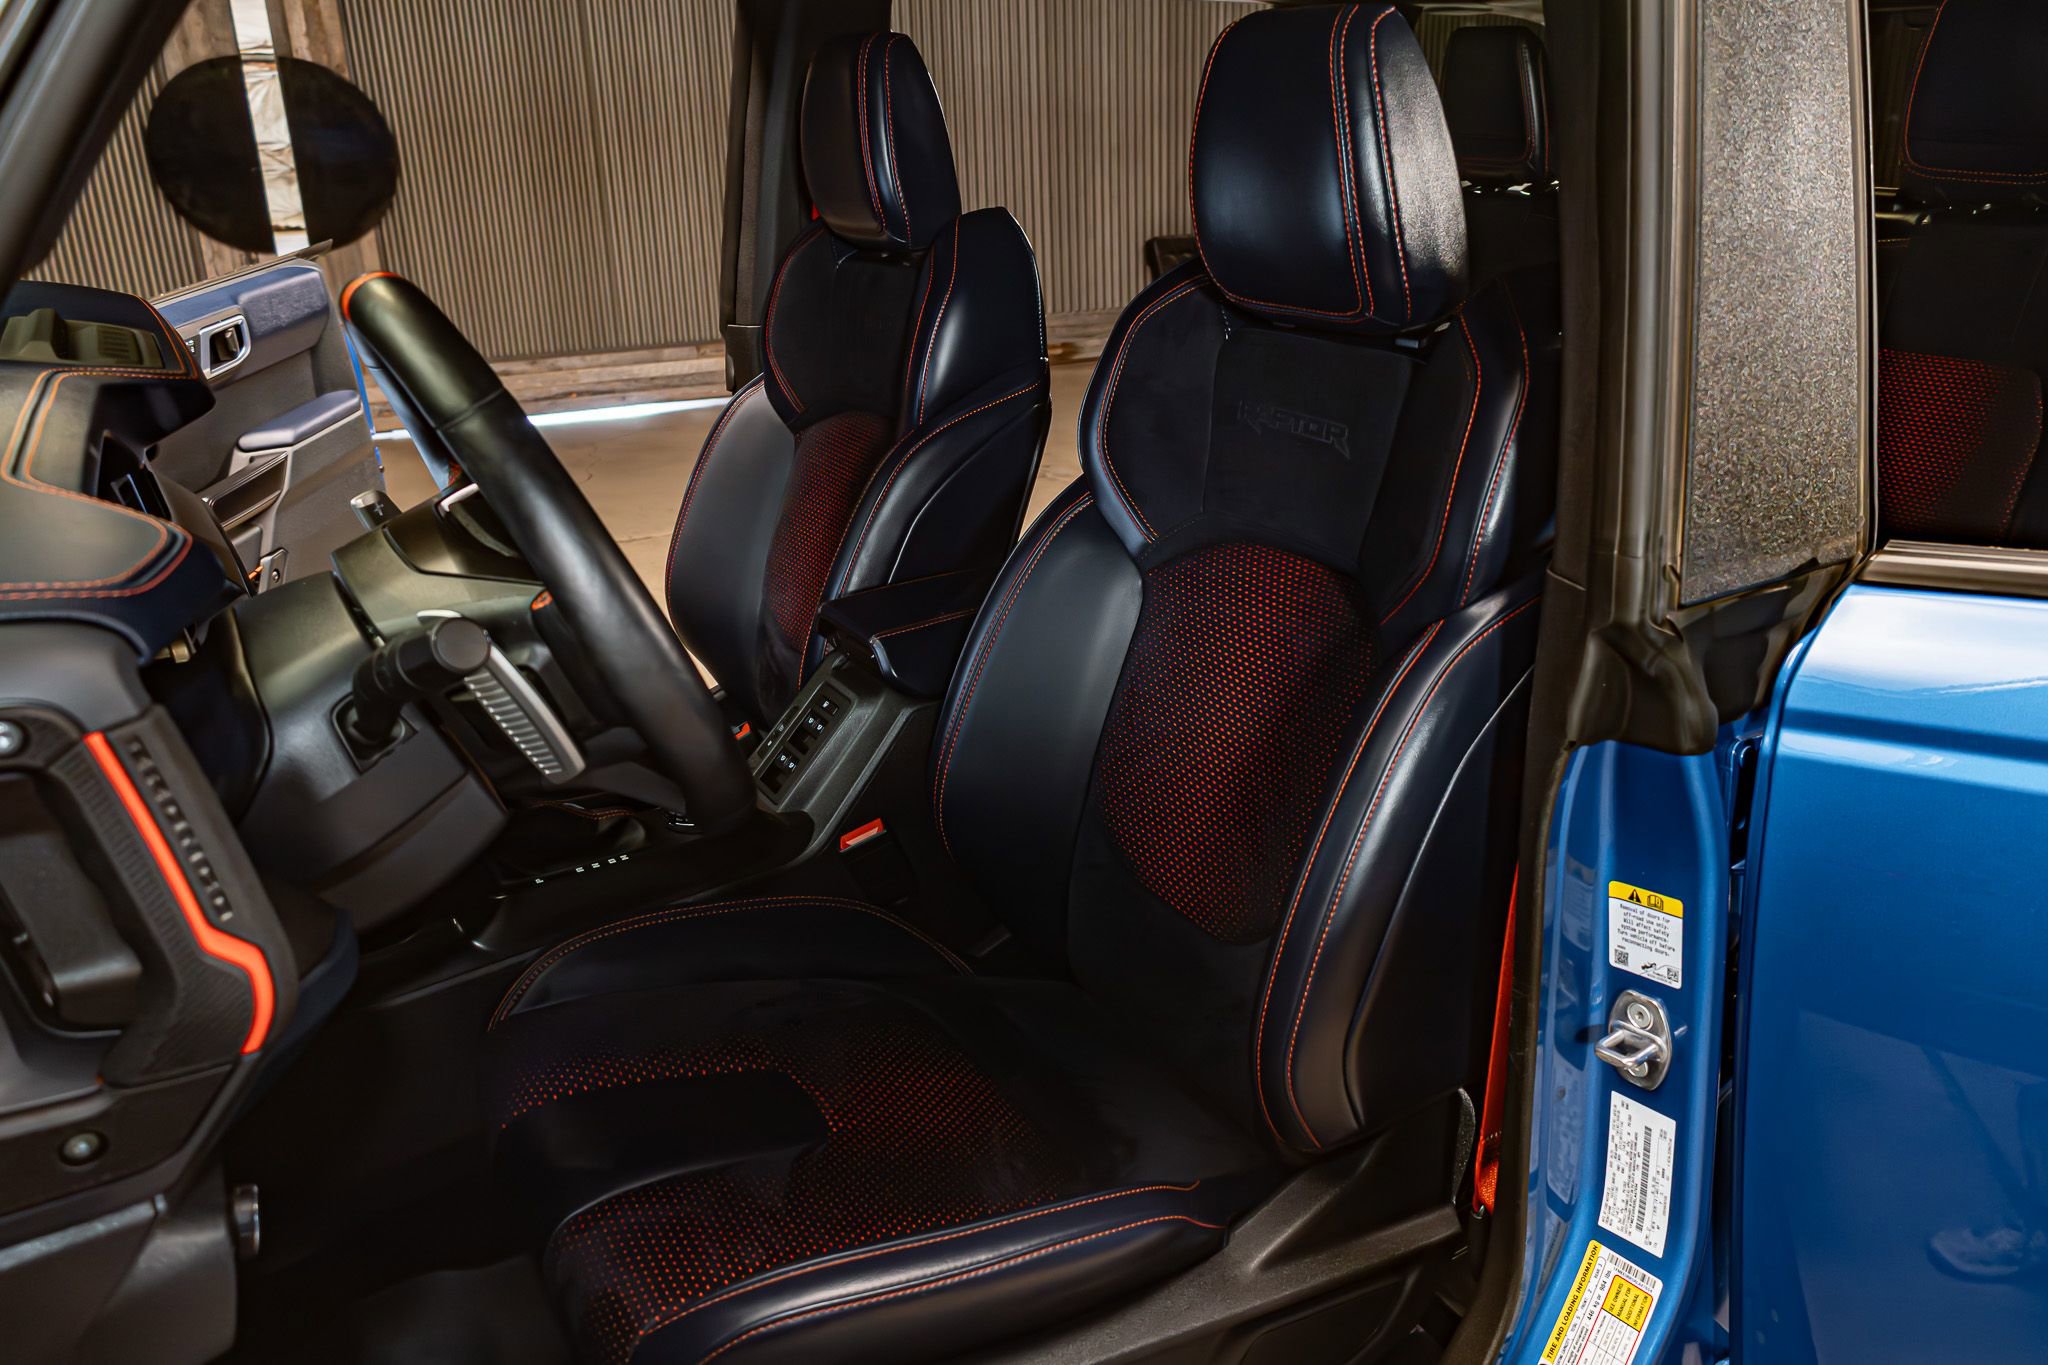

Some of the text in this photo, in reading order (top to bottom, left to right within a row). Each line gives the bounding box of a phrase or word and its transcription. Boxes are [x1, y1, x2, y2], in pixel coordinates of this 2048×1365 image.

[1546, 1342, 1557, 1359] TIRE
[1555, 1326, 1564, 1341] AND
[1563, 1294, 1578, 1325] LOADING
[1577, 1245, 1598, 1294] INFORMATION
[1586, 1309, 1594, 1320] 446
[1592, 1300, 1599, 1308] kg
[1617, 1298, 1628, 1317] MANUAL
[1624, 1286, 1632, 1297] FOR
[1624, 1292, 1640, 1320] ADDITIONAL
[1633, 1295, 1649, 1326] INFORMATION
